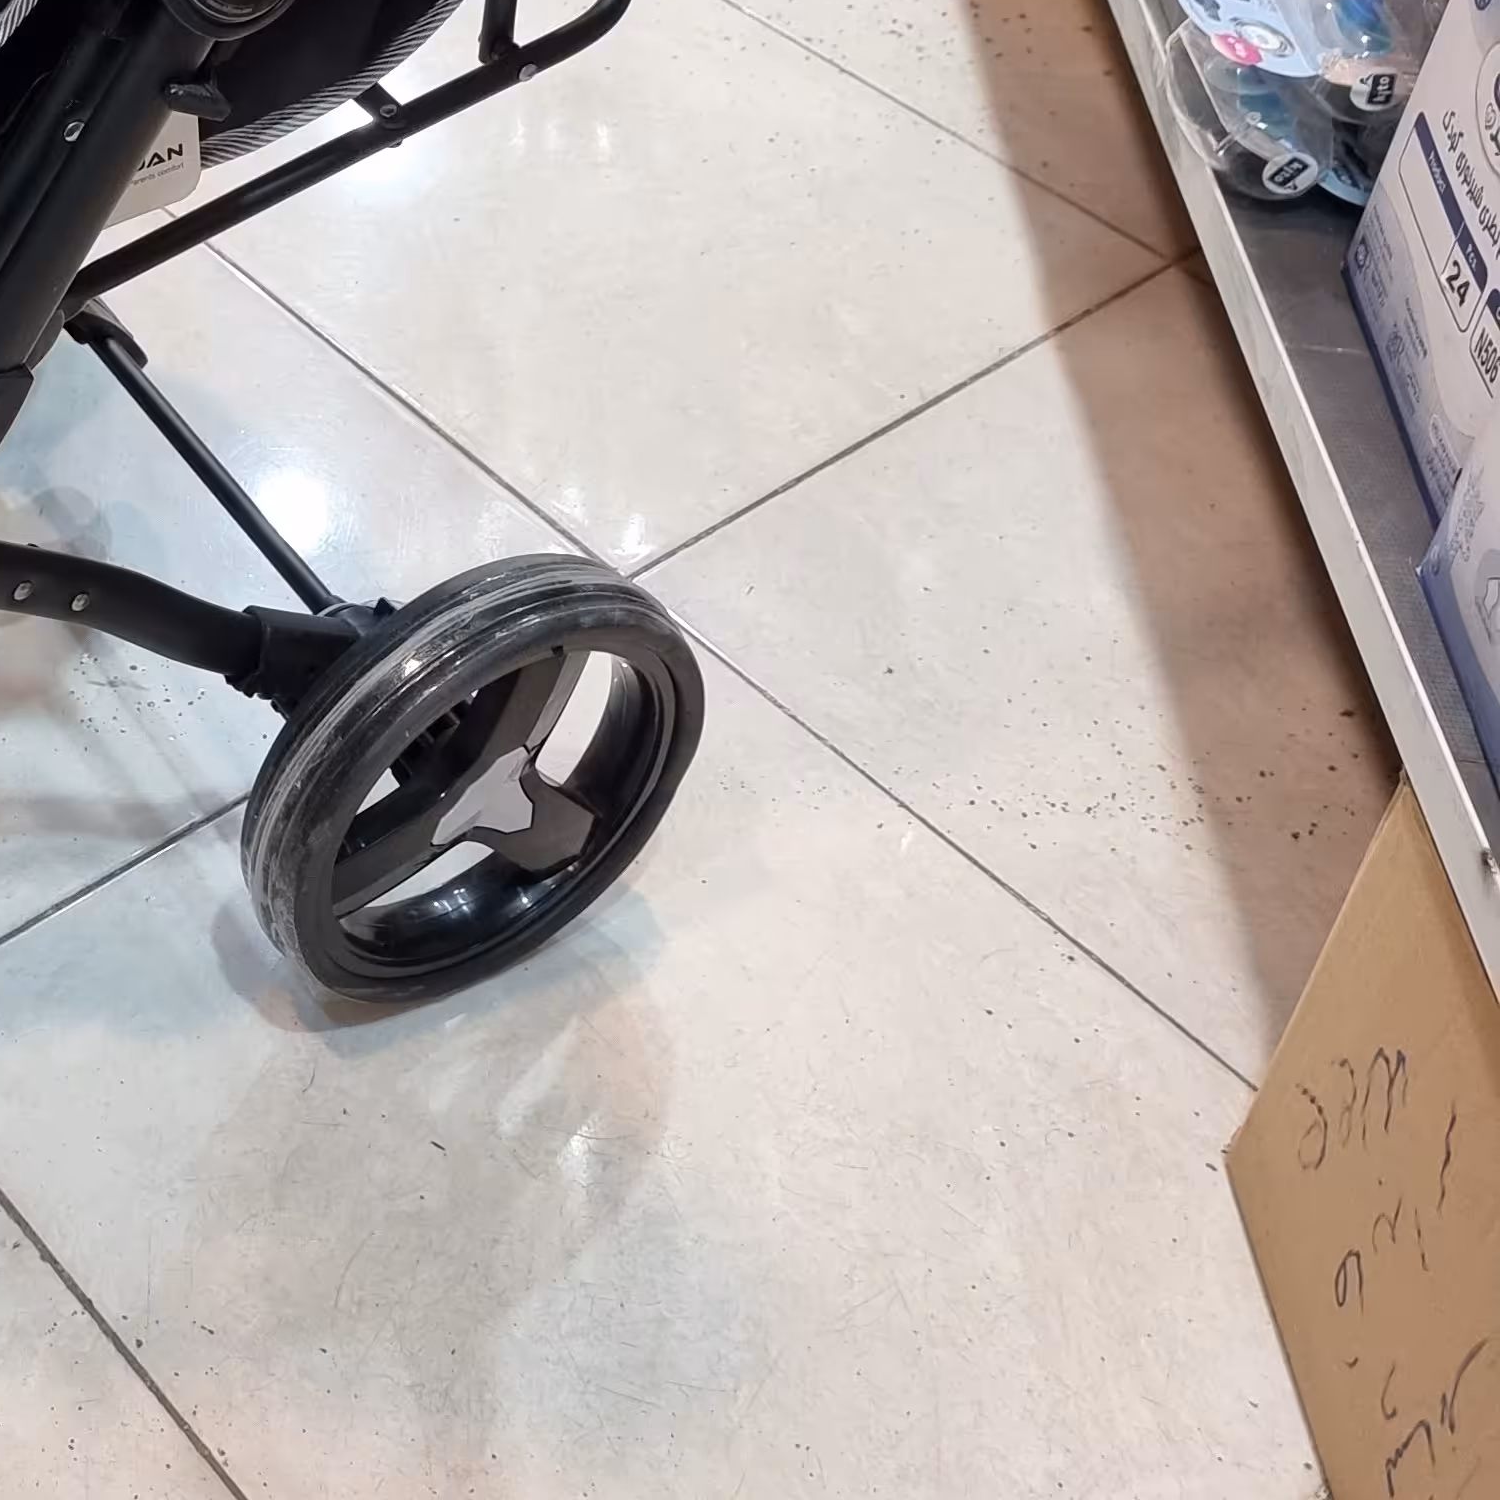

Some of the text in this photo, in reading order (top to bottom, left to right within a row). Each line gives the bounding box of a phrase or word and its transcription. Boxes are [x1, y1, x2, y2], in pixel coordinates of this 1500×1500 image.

[1372, 76, 1392, 102] kito
[1428, 150, 1447, 195] Product
[1445, 259, 1471, 307] 24
